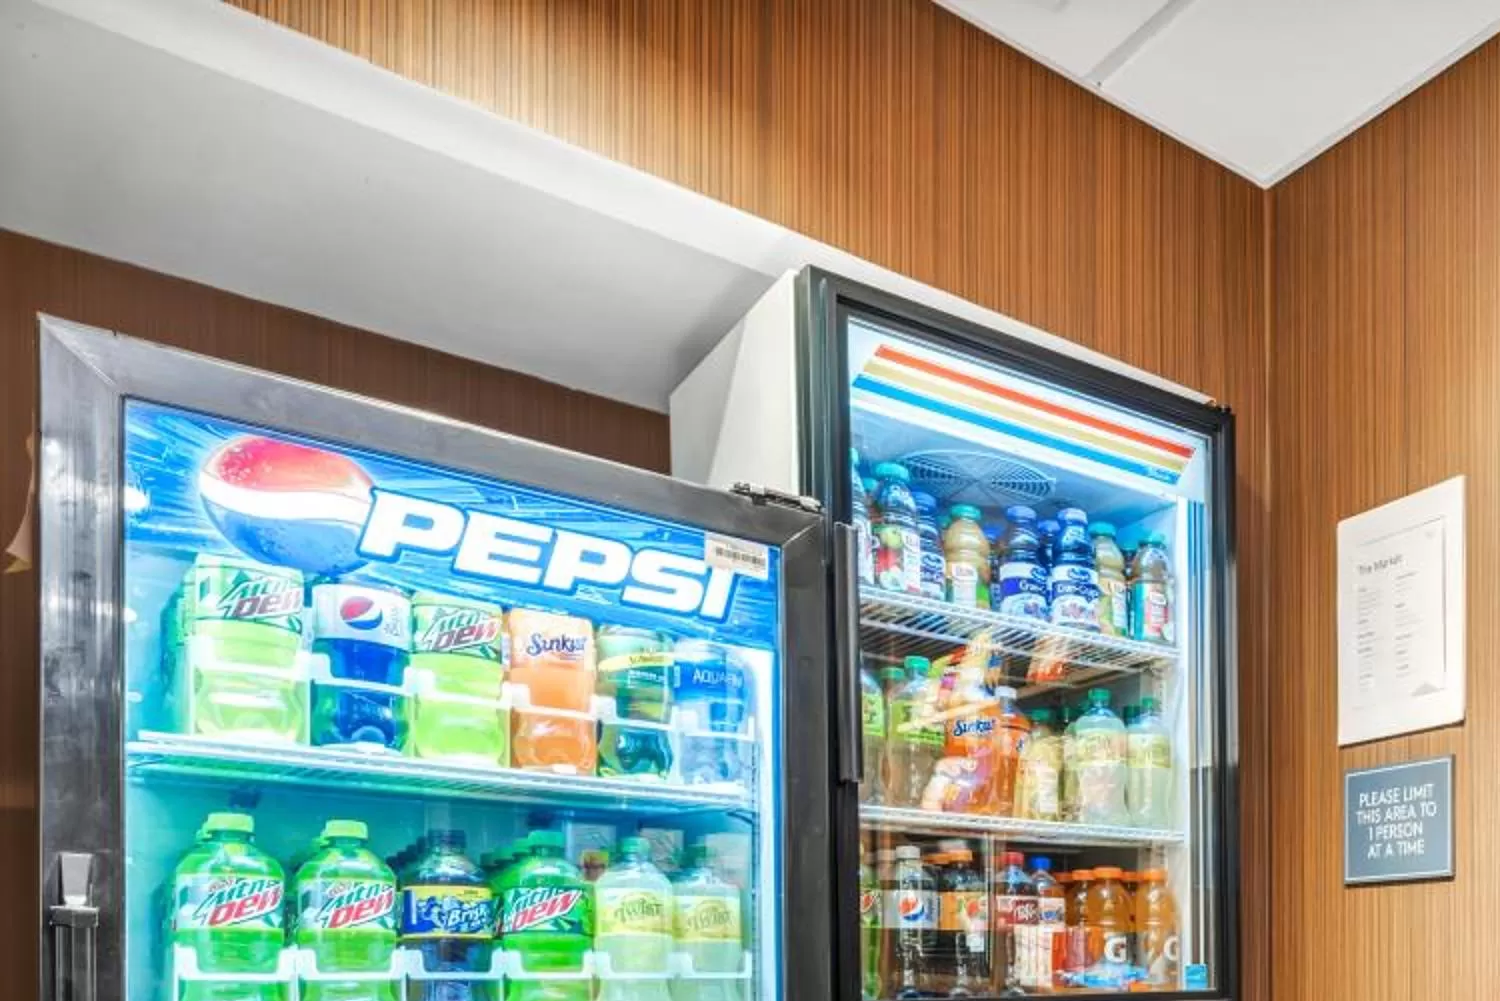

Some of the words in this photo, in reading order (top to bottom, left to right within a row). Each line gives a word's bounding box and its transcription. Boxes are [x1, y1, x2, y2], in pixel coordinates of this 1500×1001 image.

[358, 490, 740, 619] PEPSI
[1359, 787, 1400, 808] PLEASE
[1403, 783, 1435, 802] LIMIT
[1355, 808, 1381, 825] THIS
[1384, 803, 1417, 822] AREA
[1420, 801, 1437, 818] TO
[1375, 821, 1423, 840] PERSON
[1367, 842, 1382, 860] AT
[1385, 843, 1394, 858] A
[1396, 839, 1425, 858] TIME
